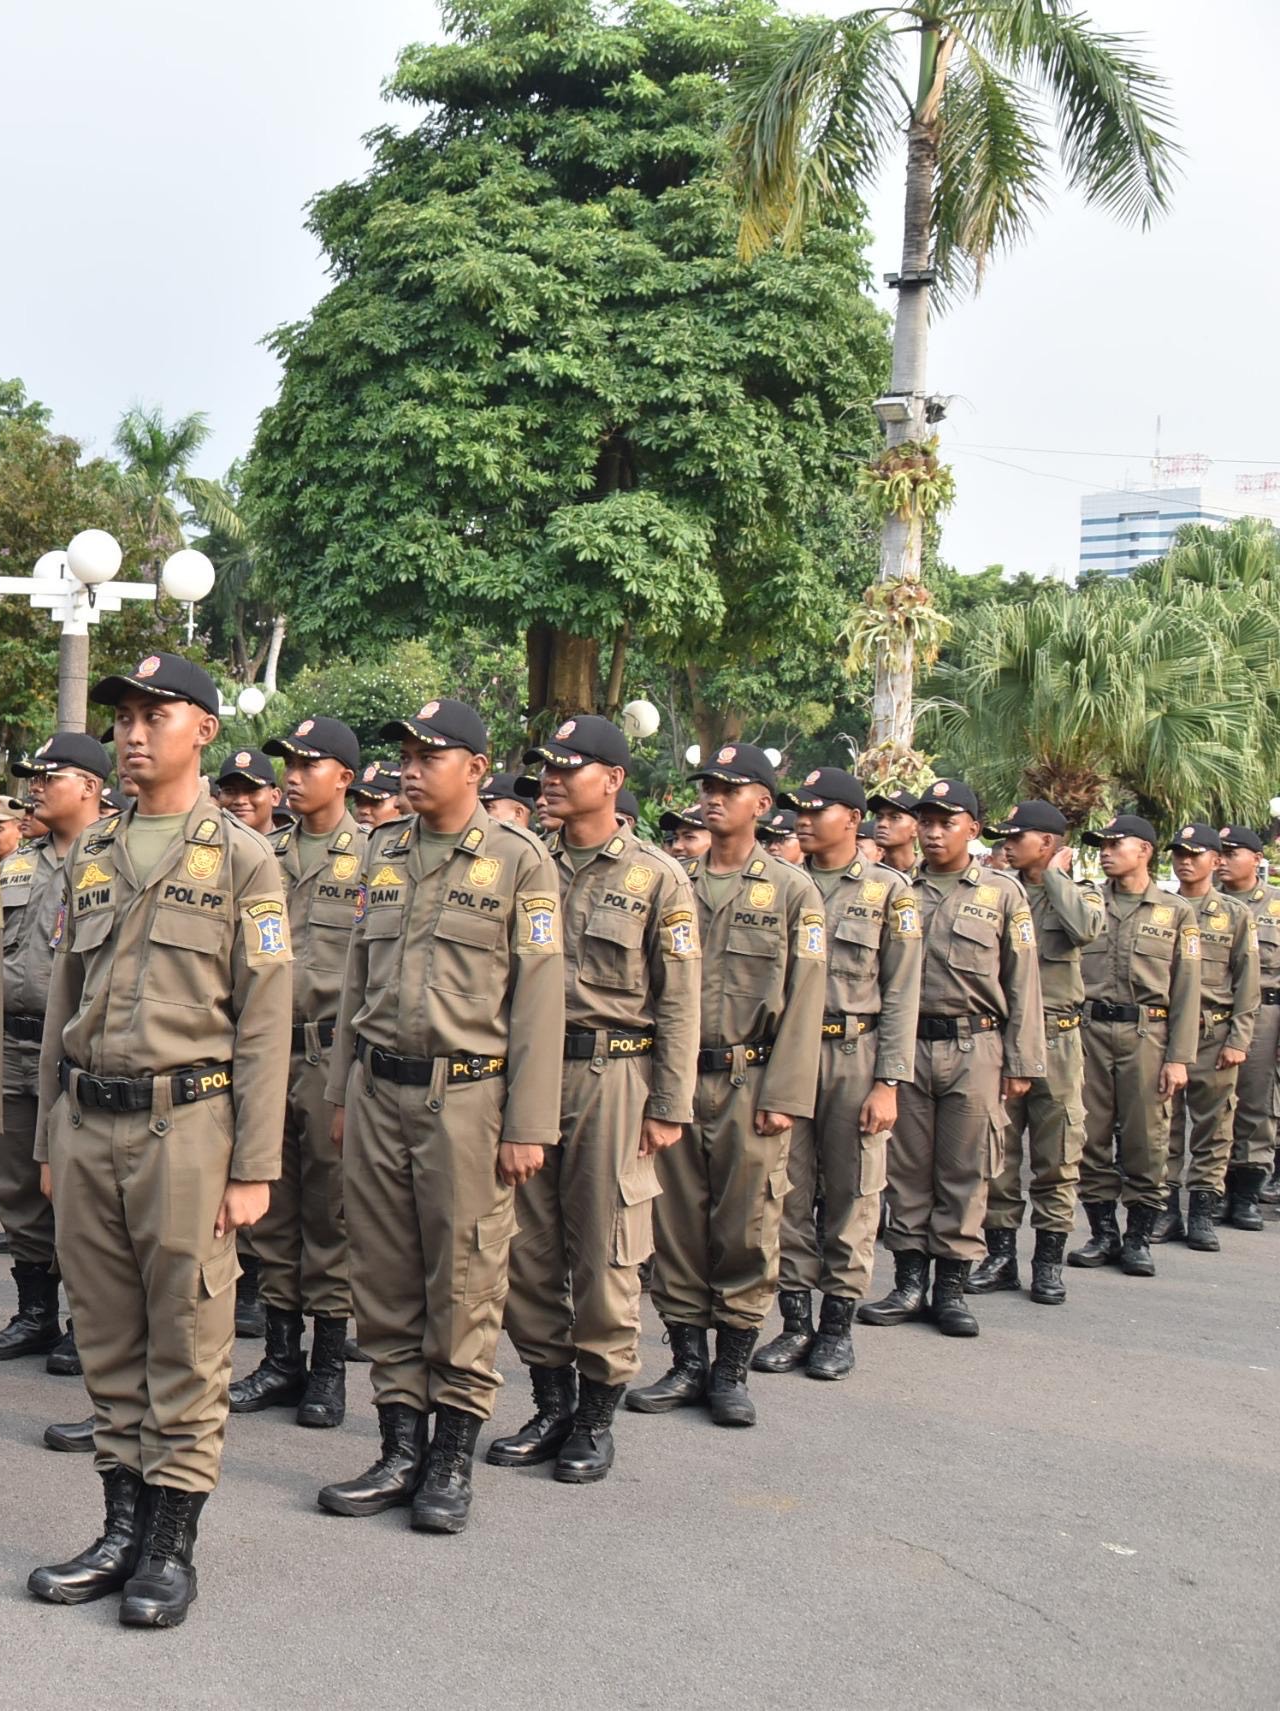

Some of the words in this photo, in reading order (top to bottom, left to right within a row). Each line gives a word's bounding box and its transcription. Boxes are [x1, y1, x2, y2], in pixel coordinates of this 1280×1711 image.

[78, 888, 110, 911] BA'IM
[164, 885, 196, 906] POL
[200, 892, 223, 909] PP
[319, 885, 341, 898] POL
[371, 889, 398, 904] DANI
[448, 890, 476, 907] POL
[480, 894, 500, 912] PP
[604, 893, 627, 910] POL
[735, 912, 758, 925] POL
[762, 916, 778, 928] PP
[847, 906, 867, 918] POL
[963, 906, 984, 919] POL
[986, 912, 999, 922] PP
[1258, 917, 1274, 925] POL
[1142, 925, 1160, 937] POL
[1200, 932, 1217, 942] POL
[201, 1072, 231, 1092] POL
